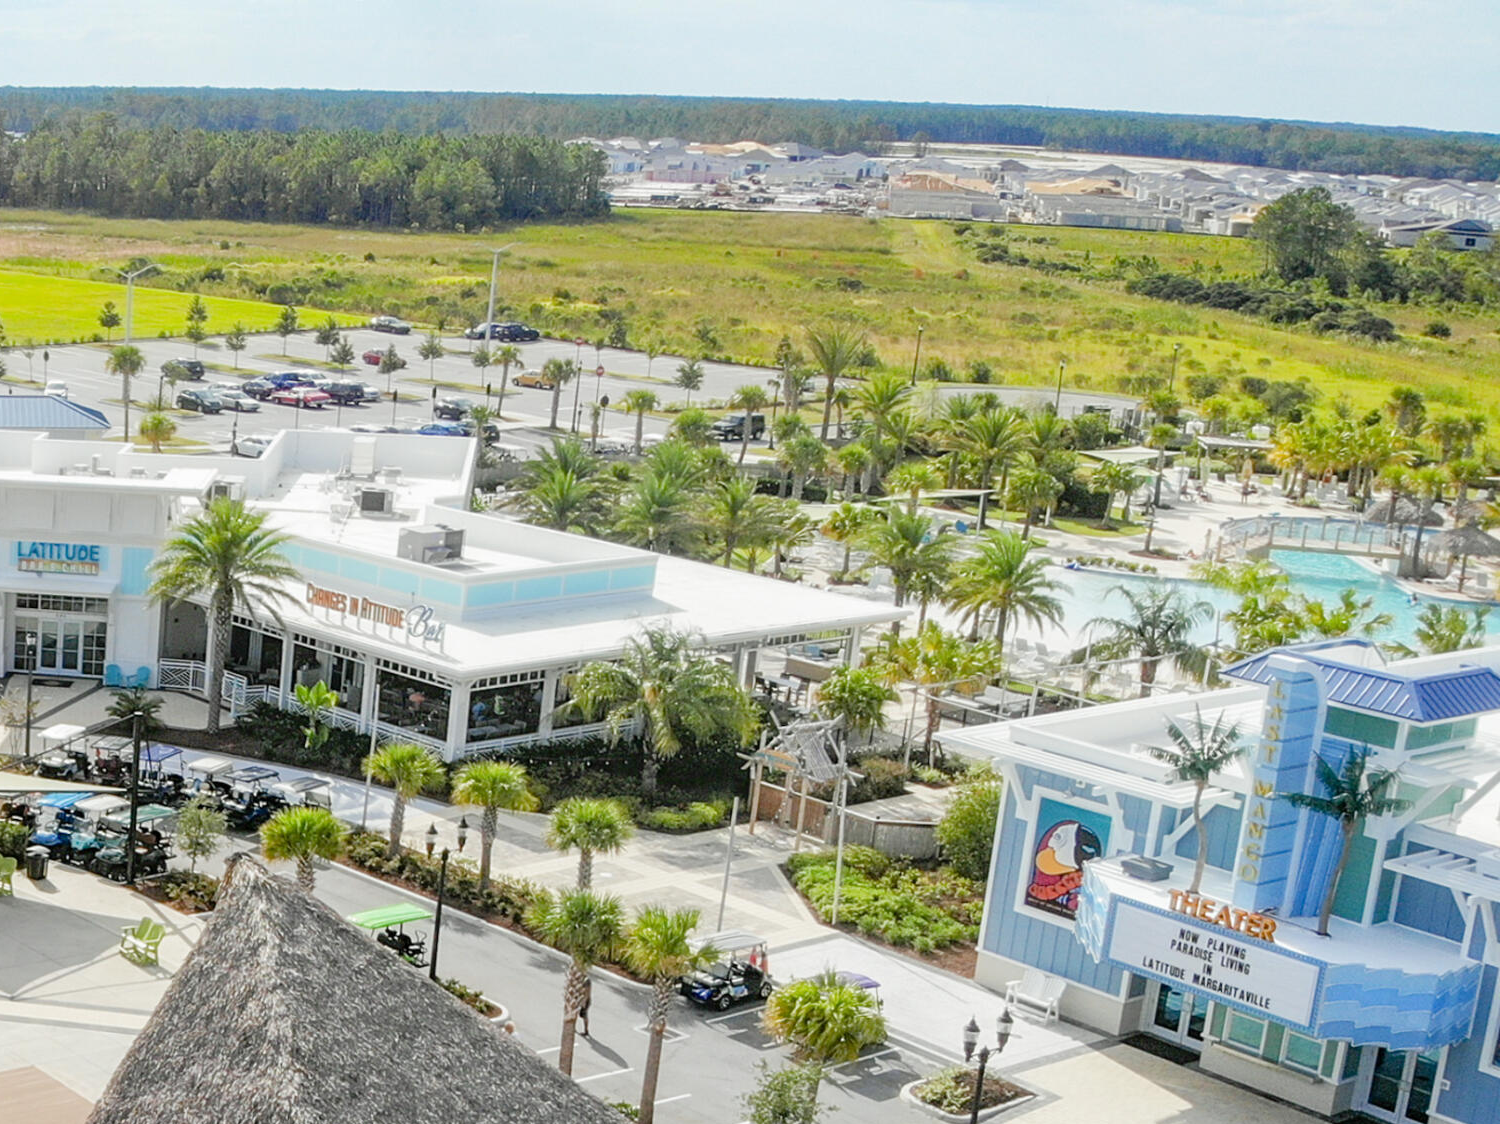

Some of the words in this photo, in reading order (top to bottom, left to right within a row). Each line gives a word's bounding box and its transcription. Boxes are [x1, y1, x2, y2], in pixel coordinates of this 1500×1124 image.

[17, 541, 100, 561] LATITUDE
[1168, 888, 1277, 943] THEATER
[1170, 939, 1213, 963] PARADISE
[1220, 958, 1251, 976] LIVING
[1178, 928, 1200, 944] NOW
[1207, 937, 1247, 960] PLAYING
[1143, 956, 1185, 980] LATITUDE
[1192, 973, 1271, 1009] MARGARITAVILLE
[1203, 963, 1213, 977] IN
